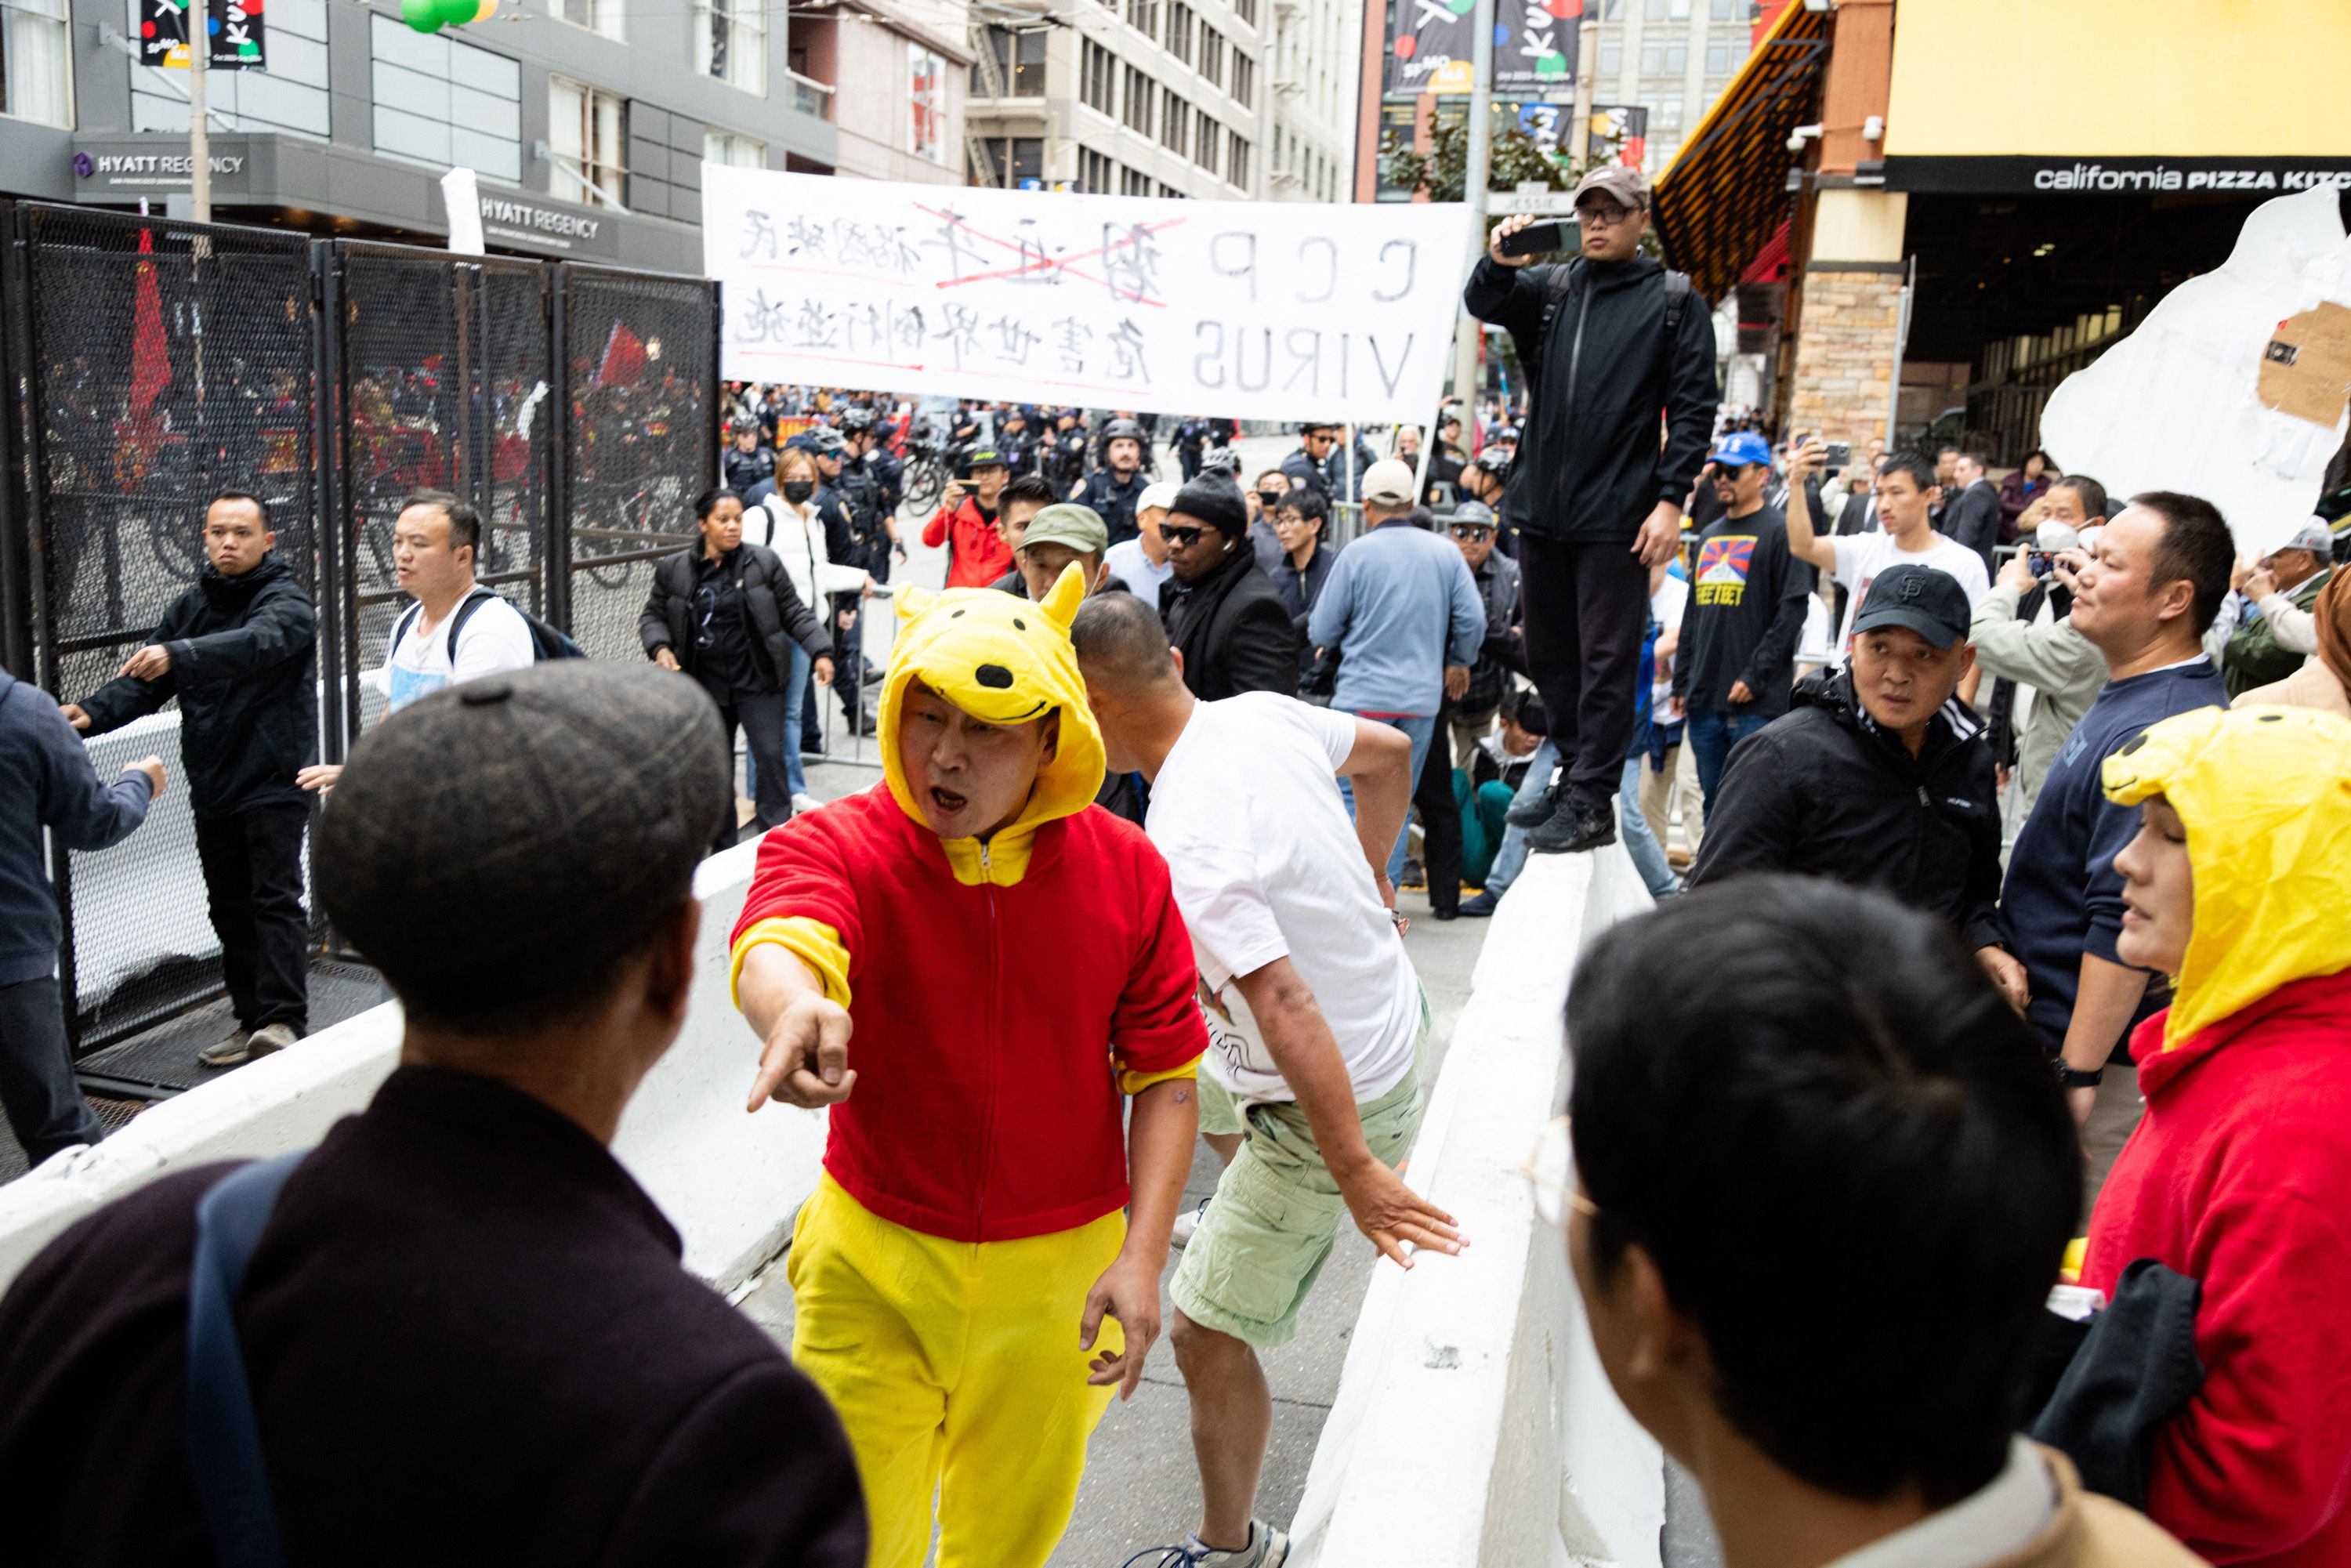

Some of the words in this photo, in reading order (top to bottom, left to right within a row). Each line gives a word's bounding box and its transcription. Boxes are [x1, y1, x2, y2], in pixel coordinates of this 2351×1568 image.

[98, 156, 158, 173] HYATT
[161, 156, 243, 174] REGNCY
[2034, 162, 2183, 190] california
[2187, 171, 2277, 190] PIZZA
[1505, 197, 1556, 210] JESSIE
[480, 197, 533, 226] HYATT
[533, 208, 599, 239] REGENCY
